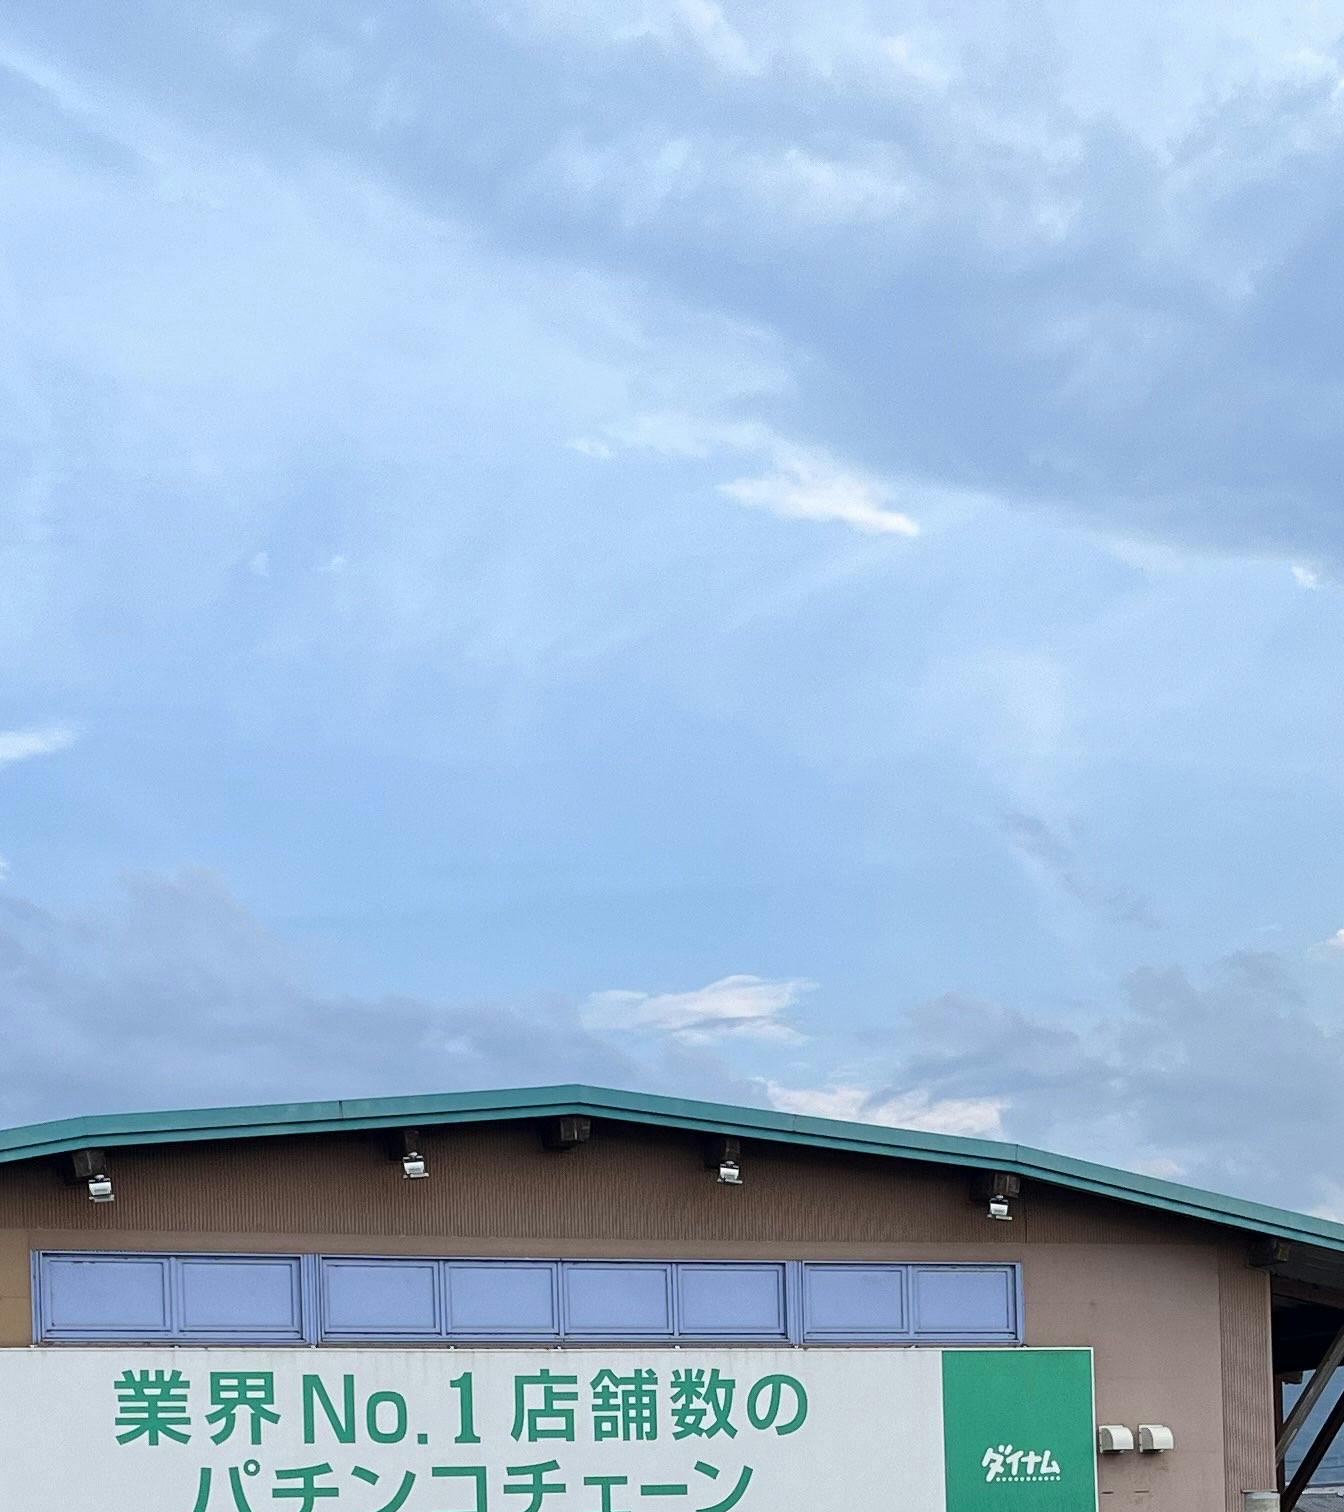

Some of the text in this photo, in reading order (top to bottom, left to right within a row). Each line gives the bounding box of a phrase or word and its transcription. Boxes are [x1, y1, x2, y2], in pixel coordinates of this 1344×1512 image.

[113, 1367, 809, 1447] 業界No.1店舗数の
[981, 1444, 1061, 1483] ダイナム
